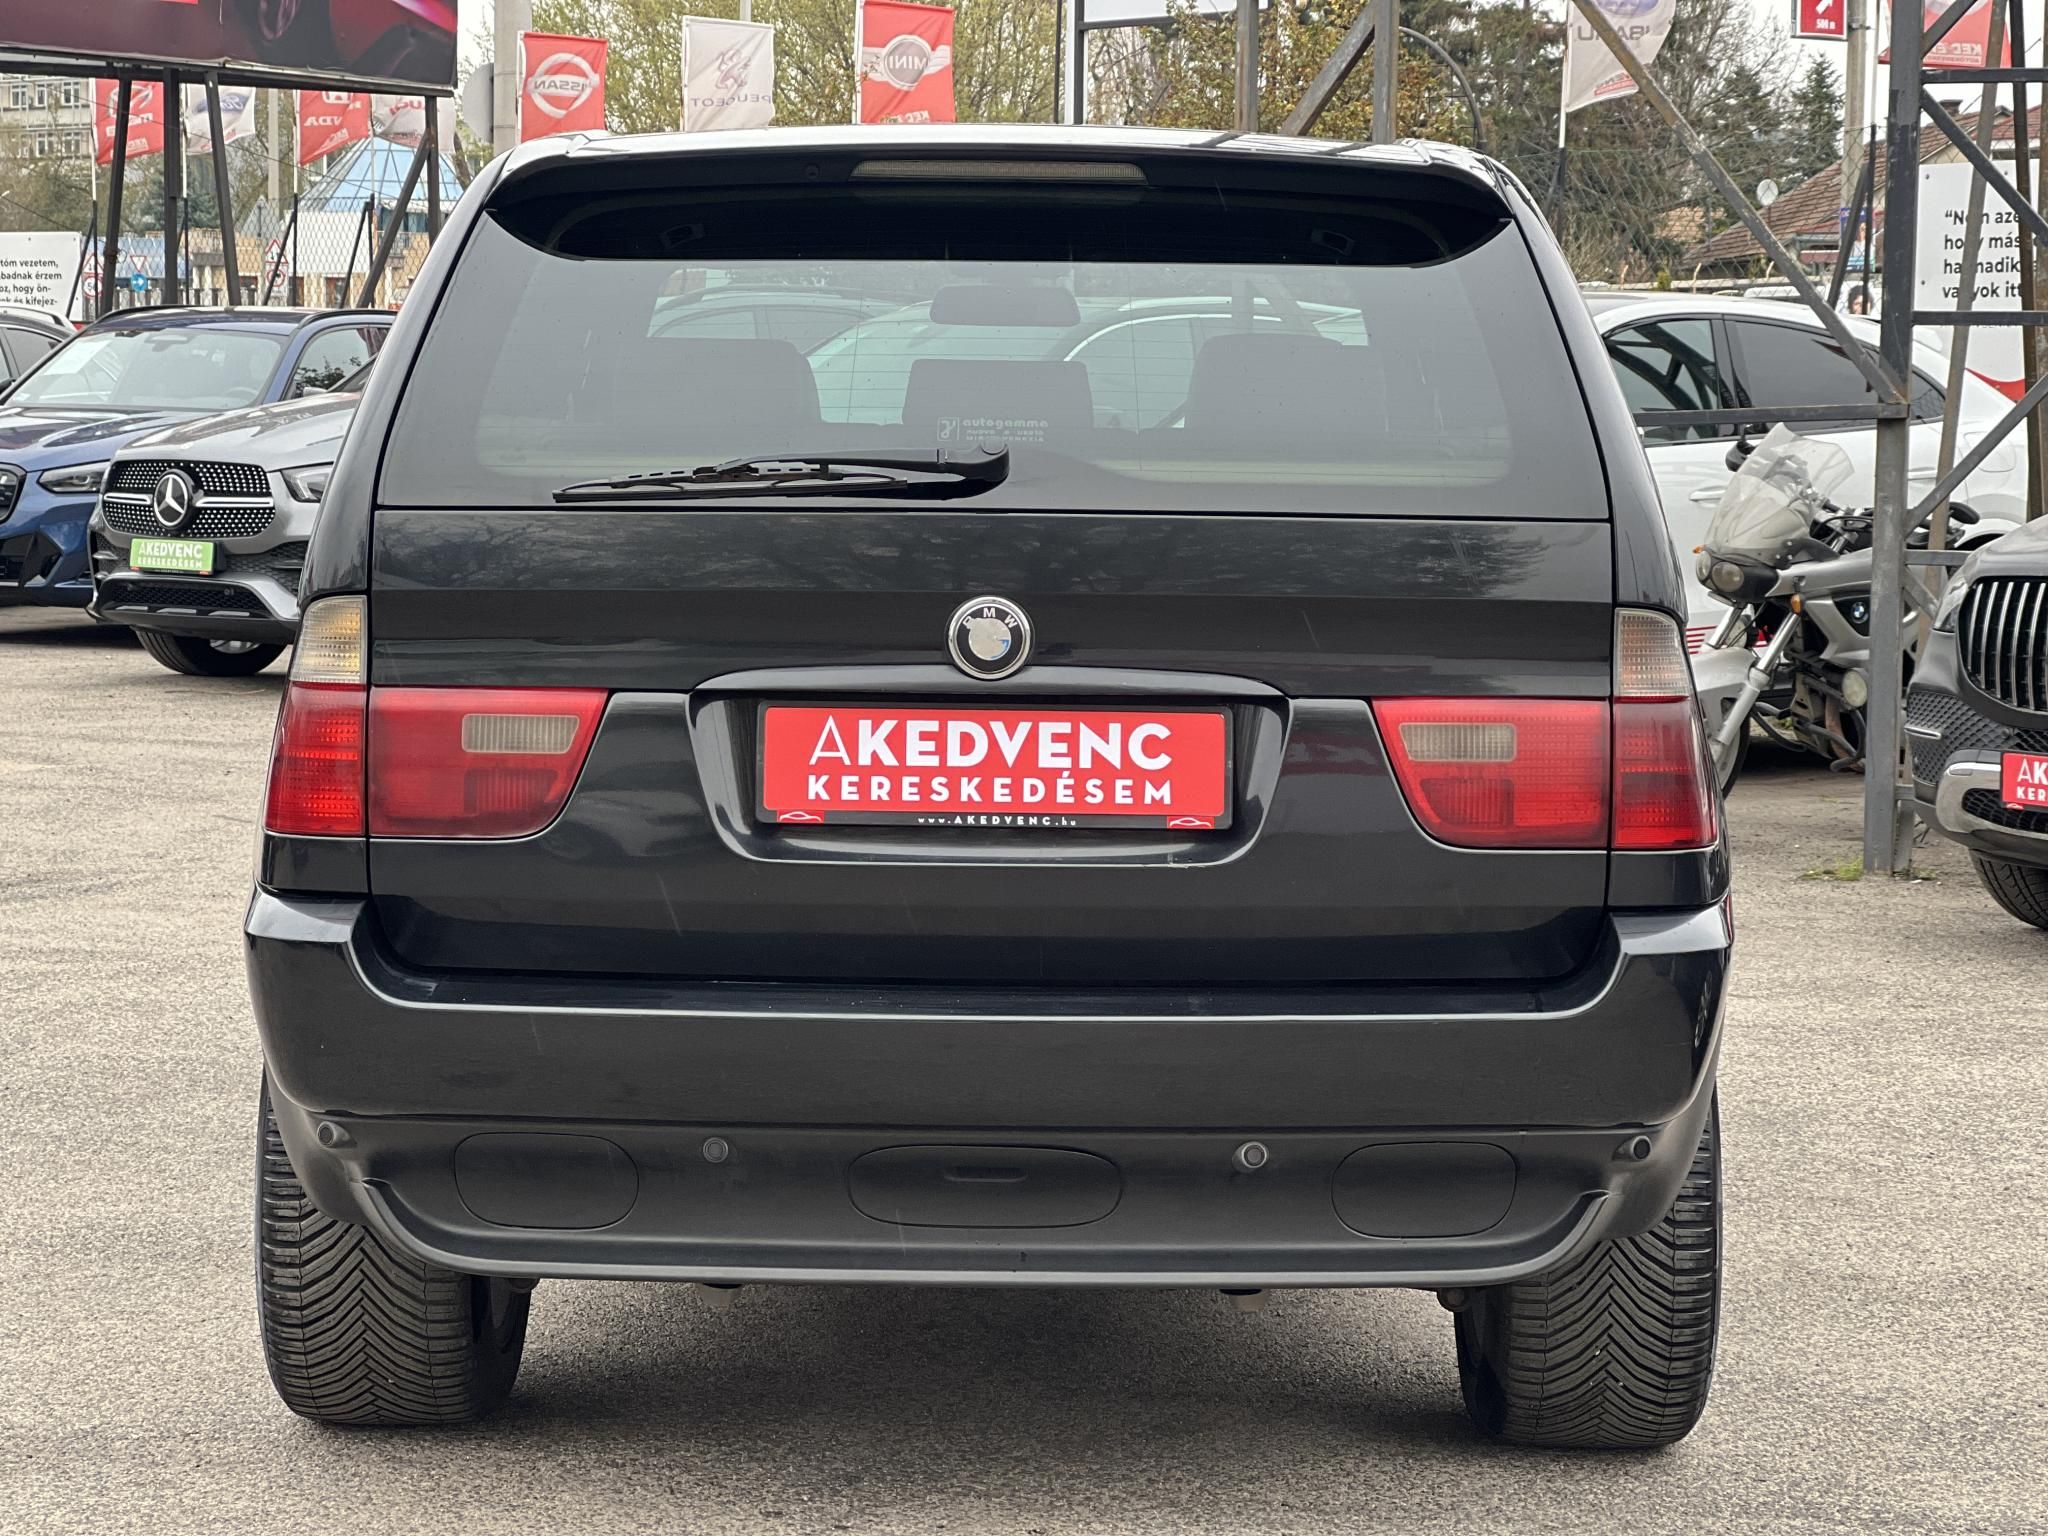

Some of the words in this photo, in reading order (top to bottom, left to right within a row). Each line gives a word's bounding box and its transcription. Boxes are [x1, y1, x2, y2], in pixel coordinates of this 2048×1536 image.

[19, 259, 58, 268] vezetem,
[35, 271, 62, 280] érzem
[13, 284, 34, 295] hogy
[139, 542, 203, 559] AKEDVENC
[809, 714, 1172, 770] AKEDVENC
[2016, 757, 2048, 786] AK
[807, 771, 1171, 805] KERESKEDÉSEM
[2016, 785, 2048, 802] KER
[918, 814, 1076, 827] www.AKEDVENC.hu
